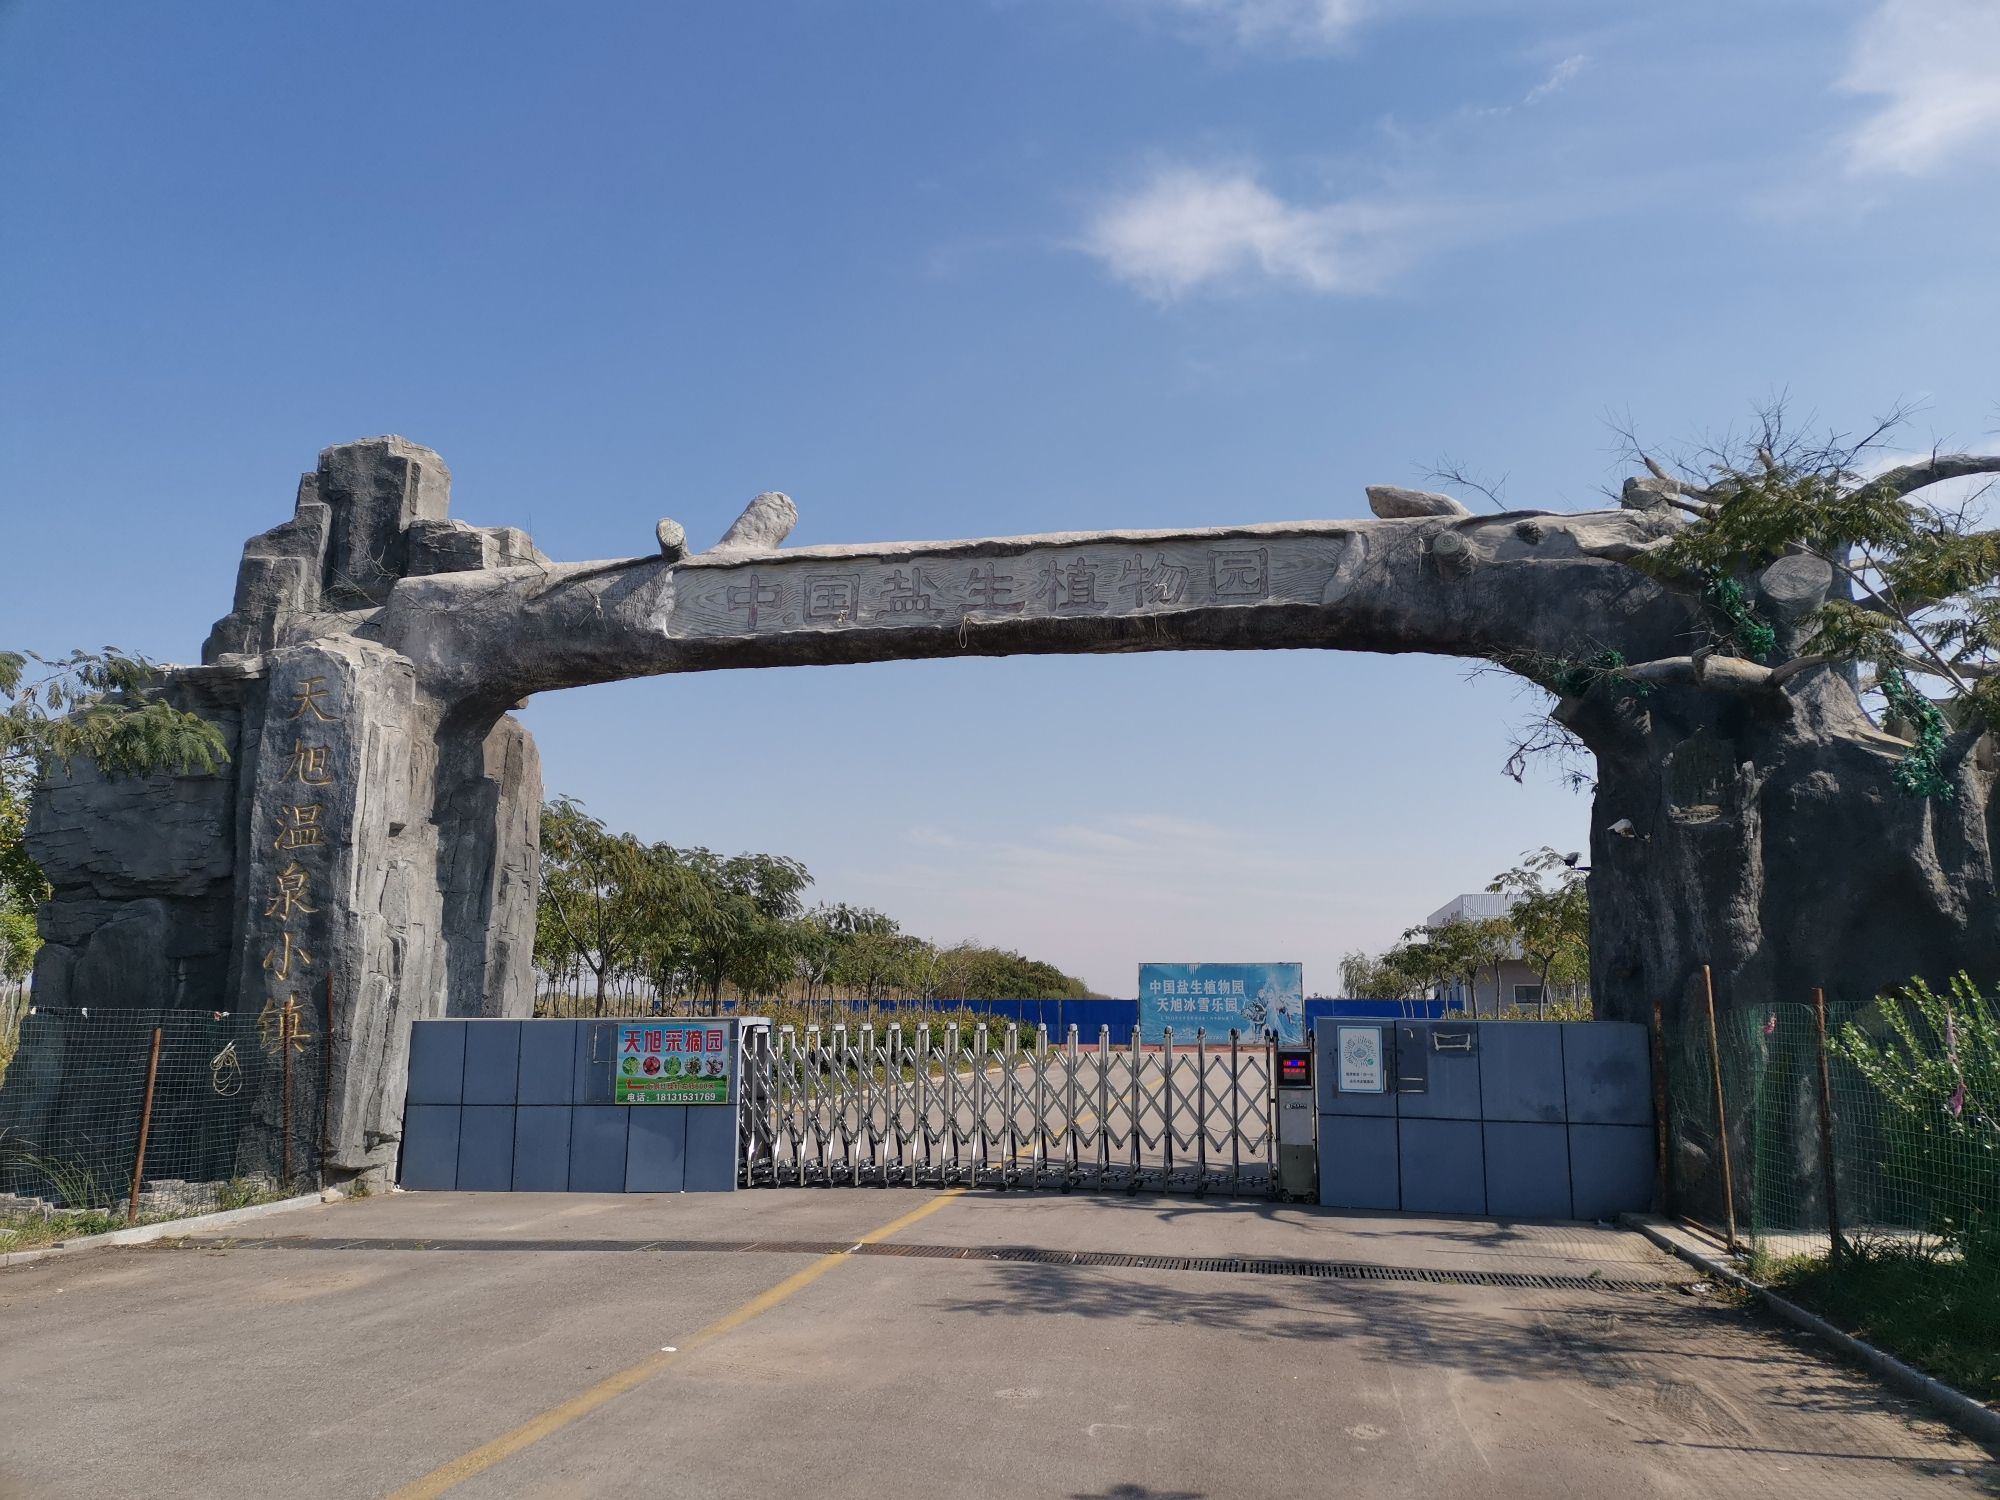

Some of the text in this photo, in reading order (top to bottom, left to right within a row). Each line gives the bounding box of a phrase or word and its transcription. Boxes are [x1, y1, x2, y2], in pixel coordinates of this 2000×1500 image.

[727, 546, 1270, 630] 中国盐生植物园
[257, 675, 340, 1054] 天旭温泉小镇
[1150, 979, 1244, 995] 中国盐生植物园
[1157, 997, 1238, 1012] 天旭冰雪乐园
[624, 1029, 723, 1053] 天旭采摘园
